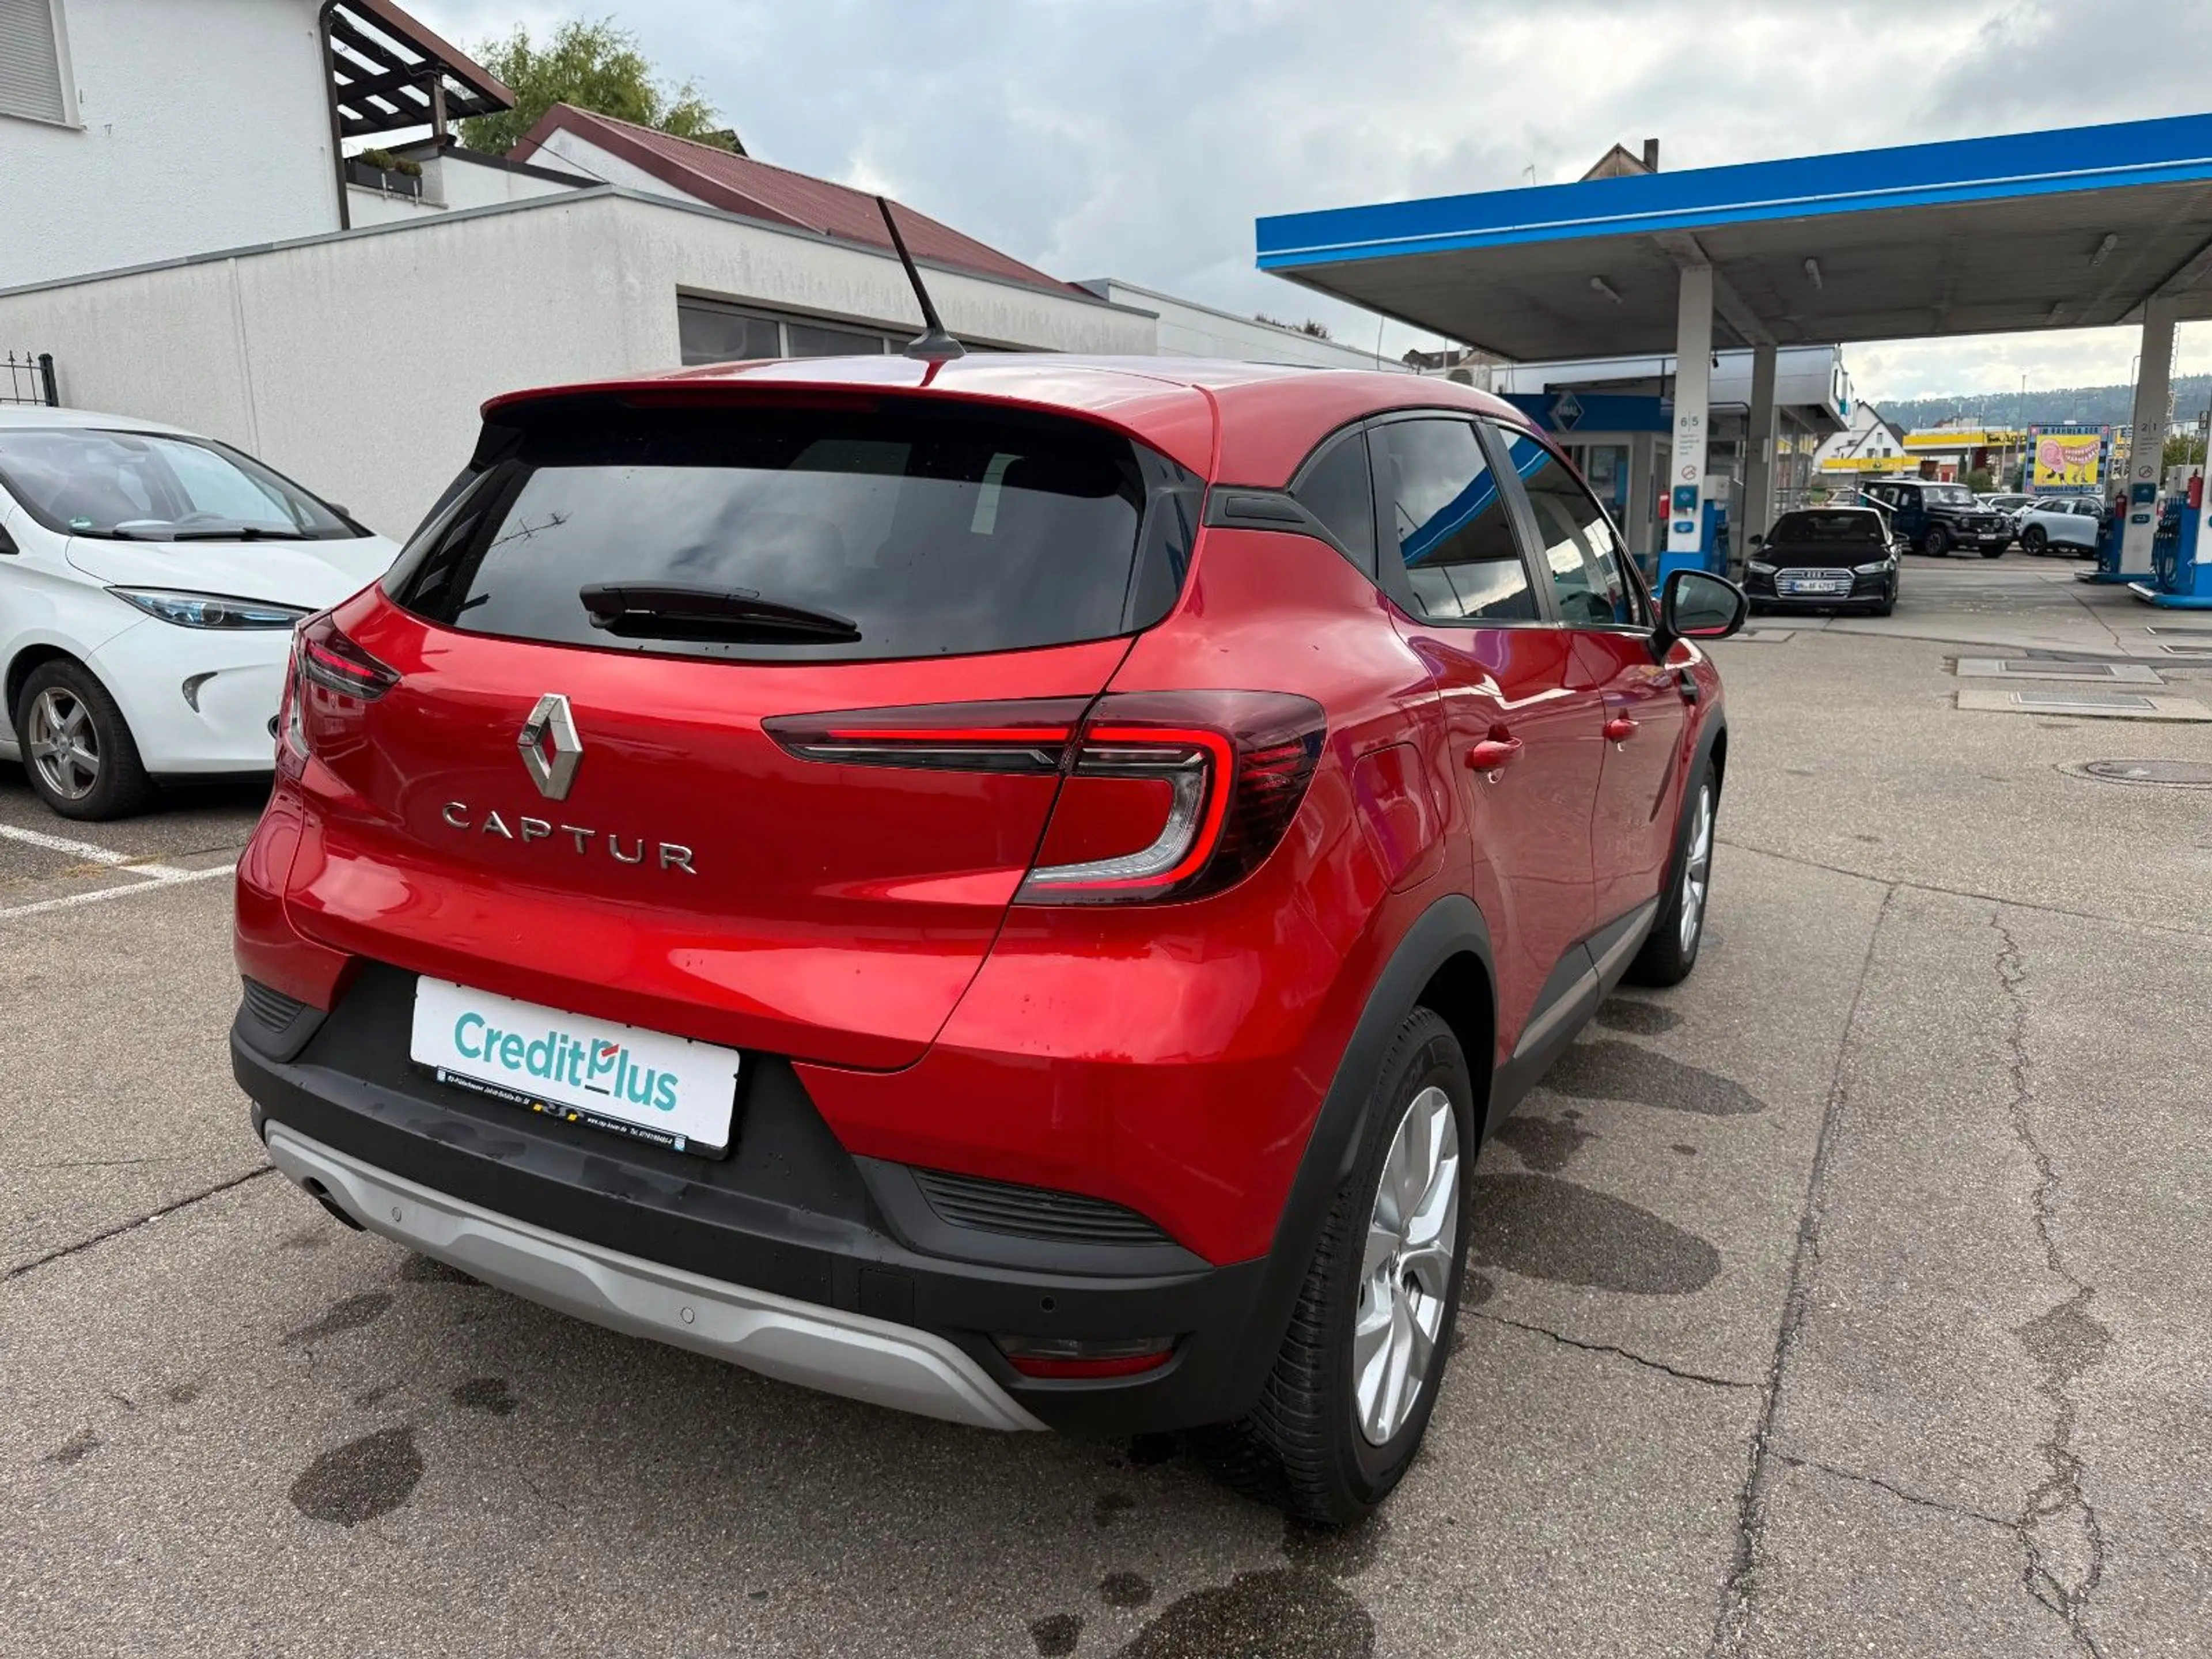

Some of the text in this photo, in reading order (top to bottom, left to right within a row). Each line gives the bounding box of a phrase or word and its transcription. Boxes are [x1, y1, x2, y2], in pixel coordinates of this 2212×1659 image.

[1680, 416, 1699, 427] 6 5
[2141, 423, 2147, 431] 2
[442, 801, 697, 874] CAPTUR
[454, 1012, 679, 1111] CreditPlus
